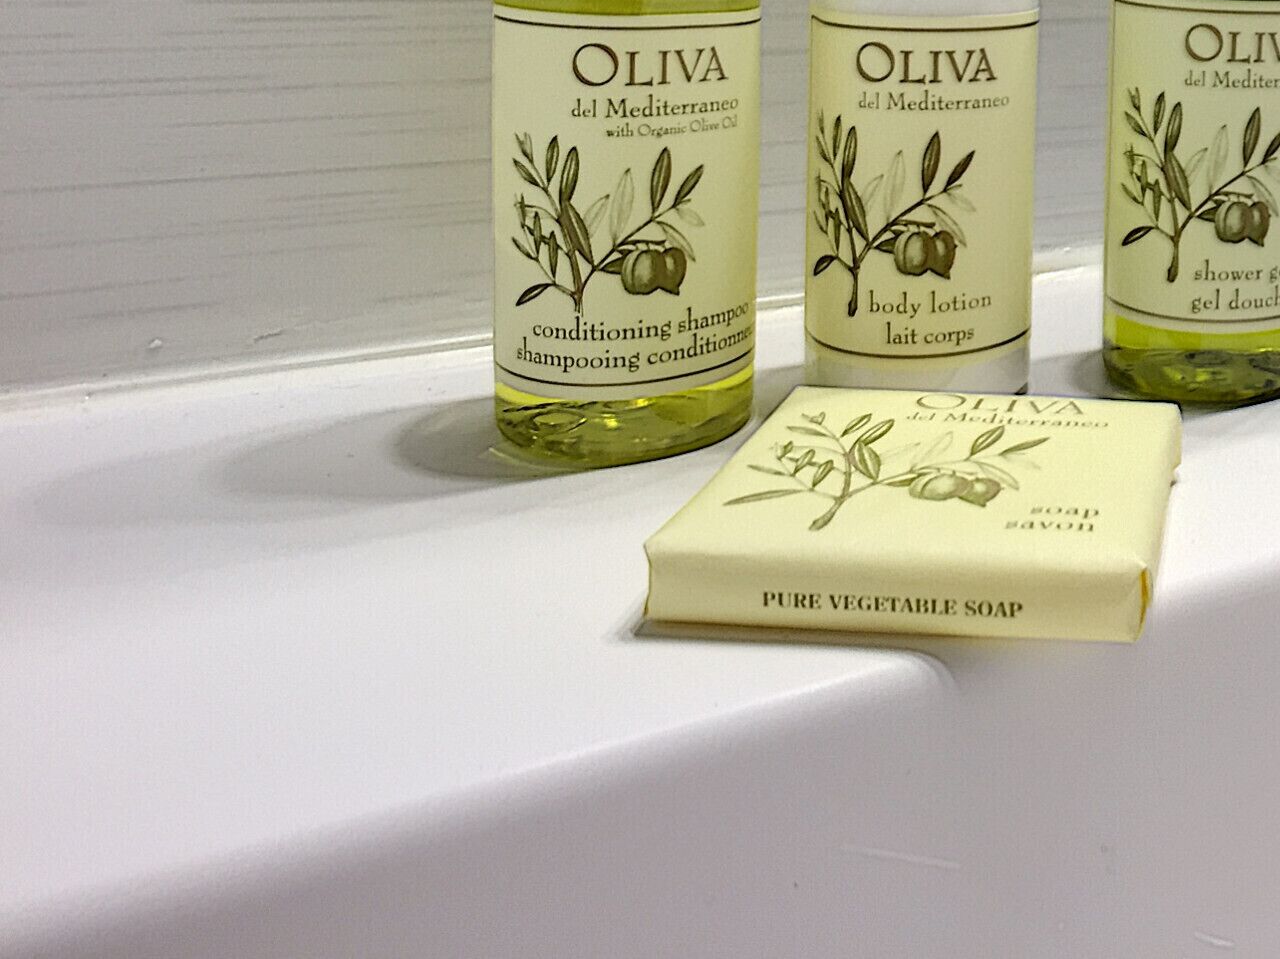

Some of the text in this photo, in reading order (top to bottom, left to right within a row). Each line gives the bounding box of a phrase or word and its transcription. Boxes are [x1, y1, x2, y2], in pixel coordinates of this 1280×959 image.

[572, 43, 728, 86] OLIVA
[856, 41, 997, 84] OLIVA
[1184, 70, 1206, 87] del
[571, 94, 739, 118] del Mediterraneo
[858, 90, 1009, 111] del Mediterraneo
[606, 114, 738, 138] with Organic Olive Oil
[1194, 259, 1263, 281] shower
[869, 290, 992, 318] body lotion
[1191, 289, 1219, 314] gel
[533, 302, 749, 341] conditioning shampoo
[886, 322, 975, 345] lait corps
[517, 337, 641, 372] shampooing
[916, 393, 1084, 415] OLIVA
[906, 412, 1109, 427] del Mediterraneo
[1031, 503, 1100, 519] soap
[1004, 520, 1094, 532] savon
[762, 592, 1024, 618] PURE VEGETABLE SOAP
